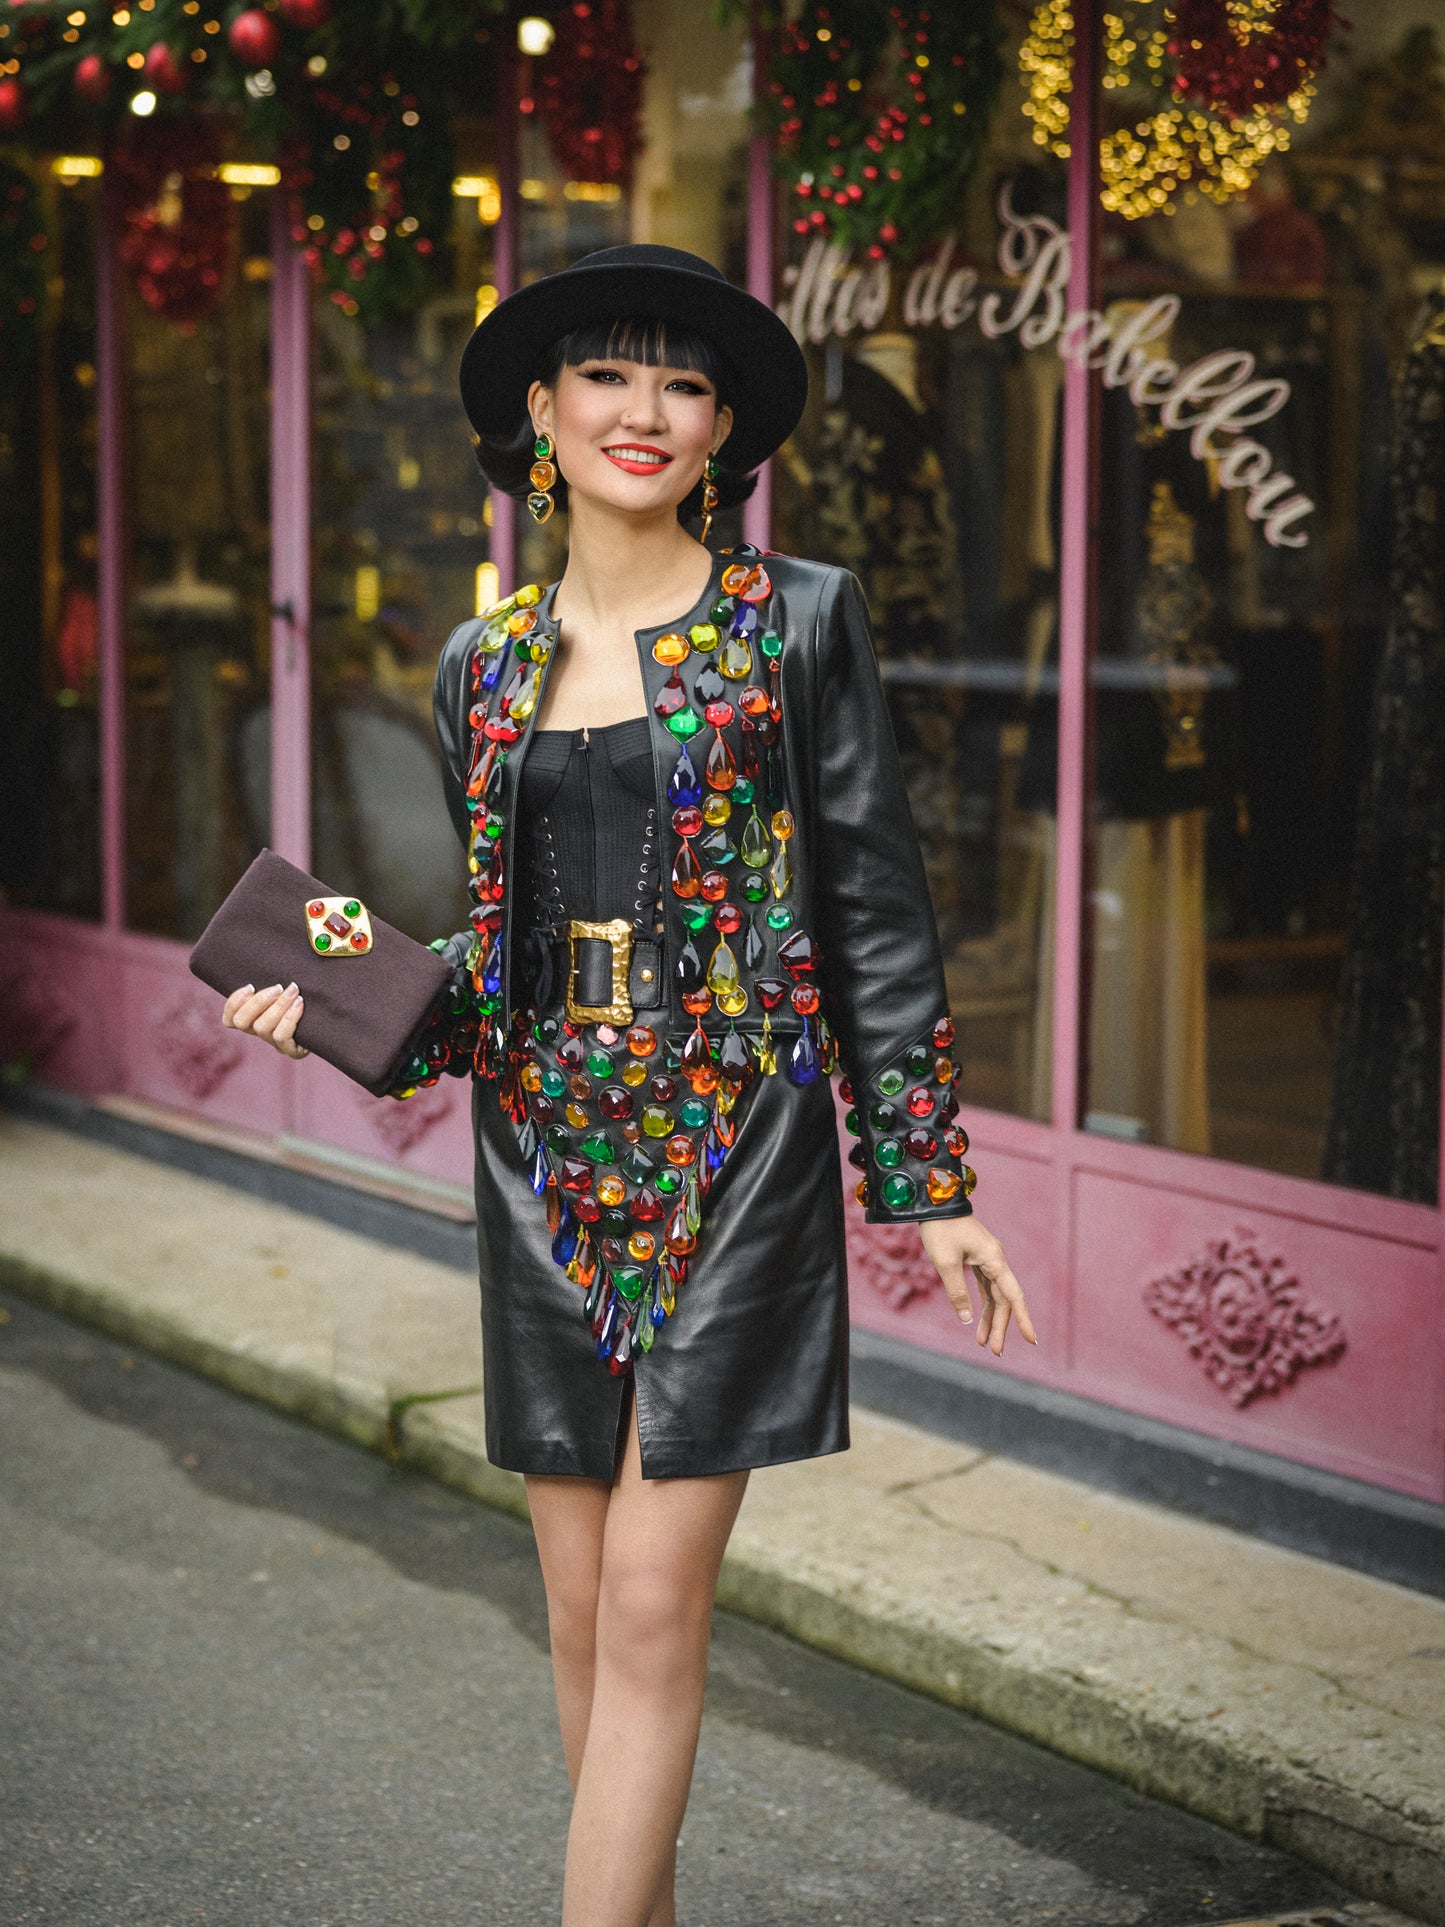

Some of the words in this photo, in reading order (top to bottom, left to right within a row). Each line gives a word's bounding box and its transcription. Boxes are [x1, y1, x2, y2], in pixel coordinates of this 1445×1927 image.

[774, 236, 890, 345] illes
[903, 234, 978, 330] de
[979, 182, 1315, 548] Babellou
